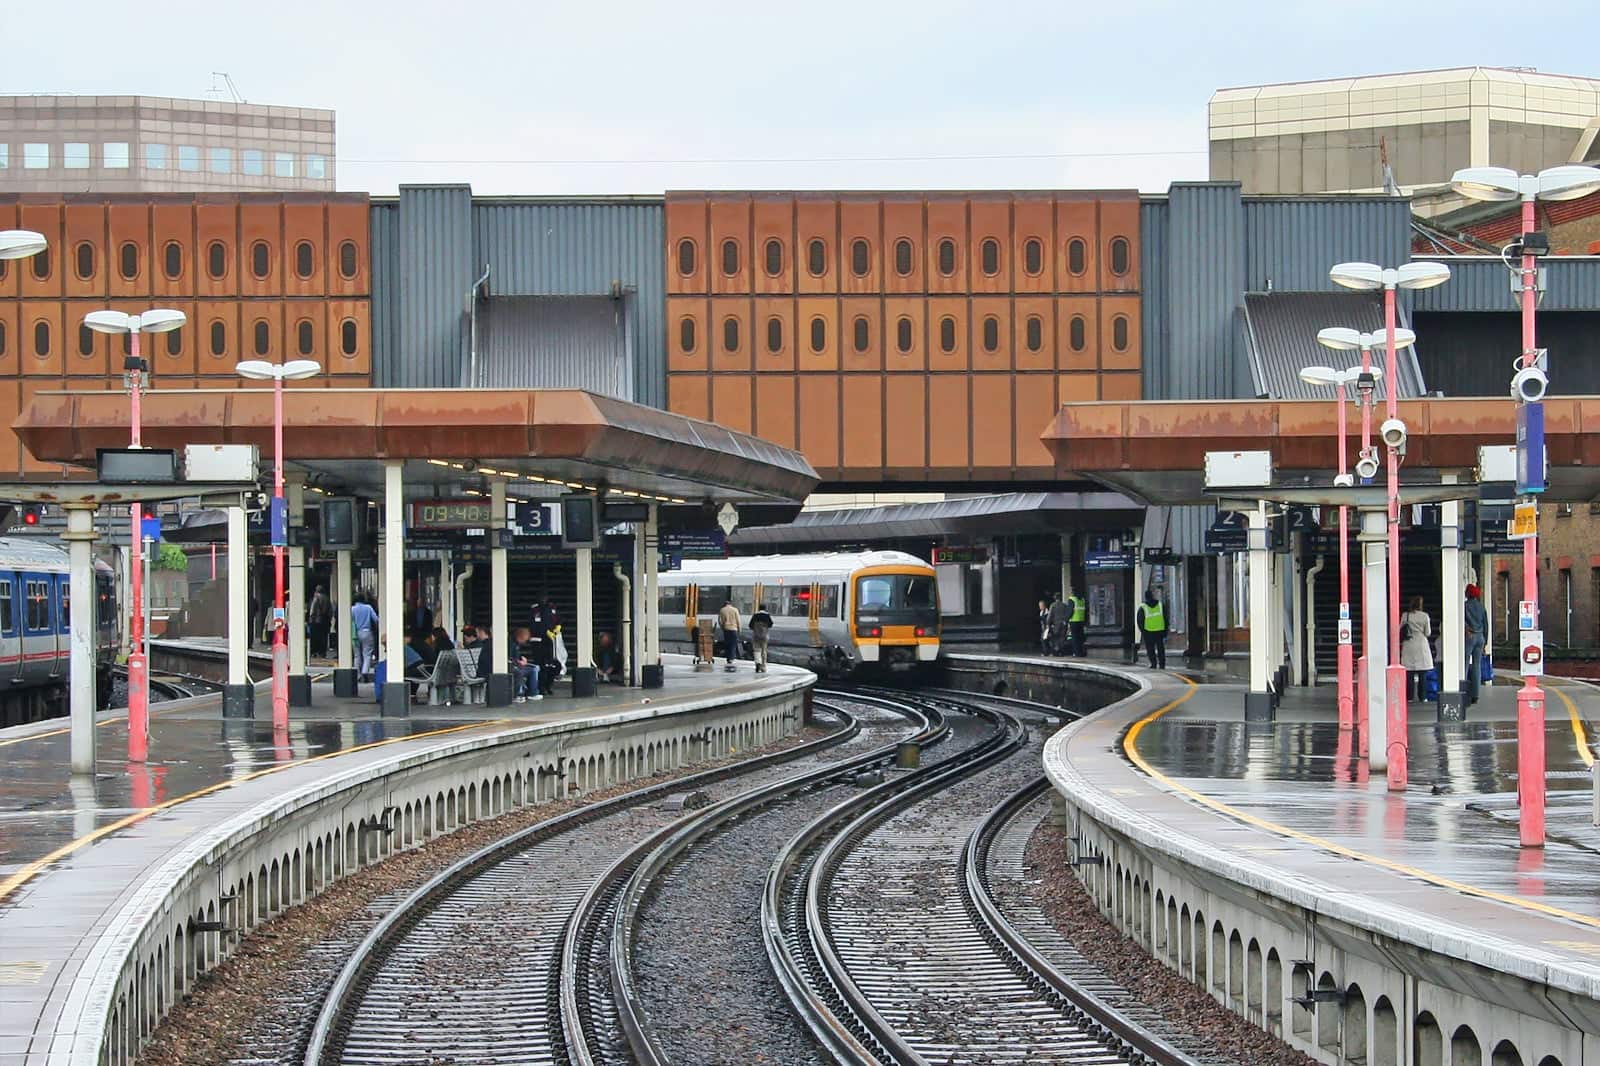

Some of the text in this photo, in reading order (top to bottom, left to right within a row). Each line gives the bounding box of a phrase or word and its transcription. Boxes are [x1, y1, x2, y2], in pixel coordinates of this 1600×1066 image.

[250, 511, 264, 526] 4
[529, 509, 542, 528] 3
[1222, 511, 1235, 525] 2
[1293, 511, 1305, 527] 2
